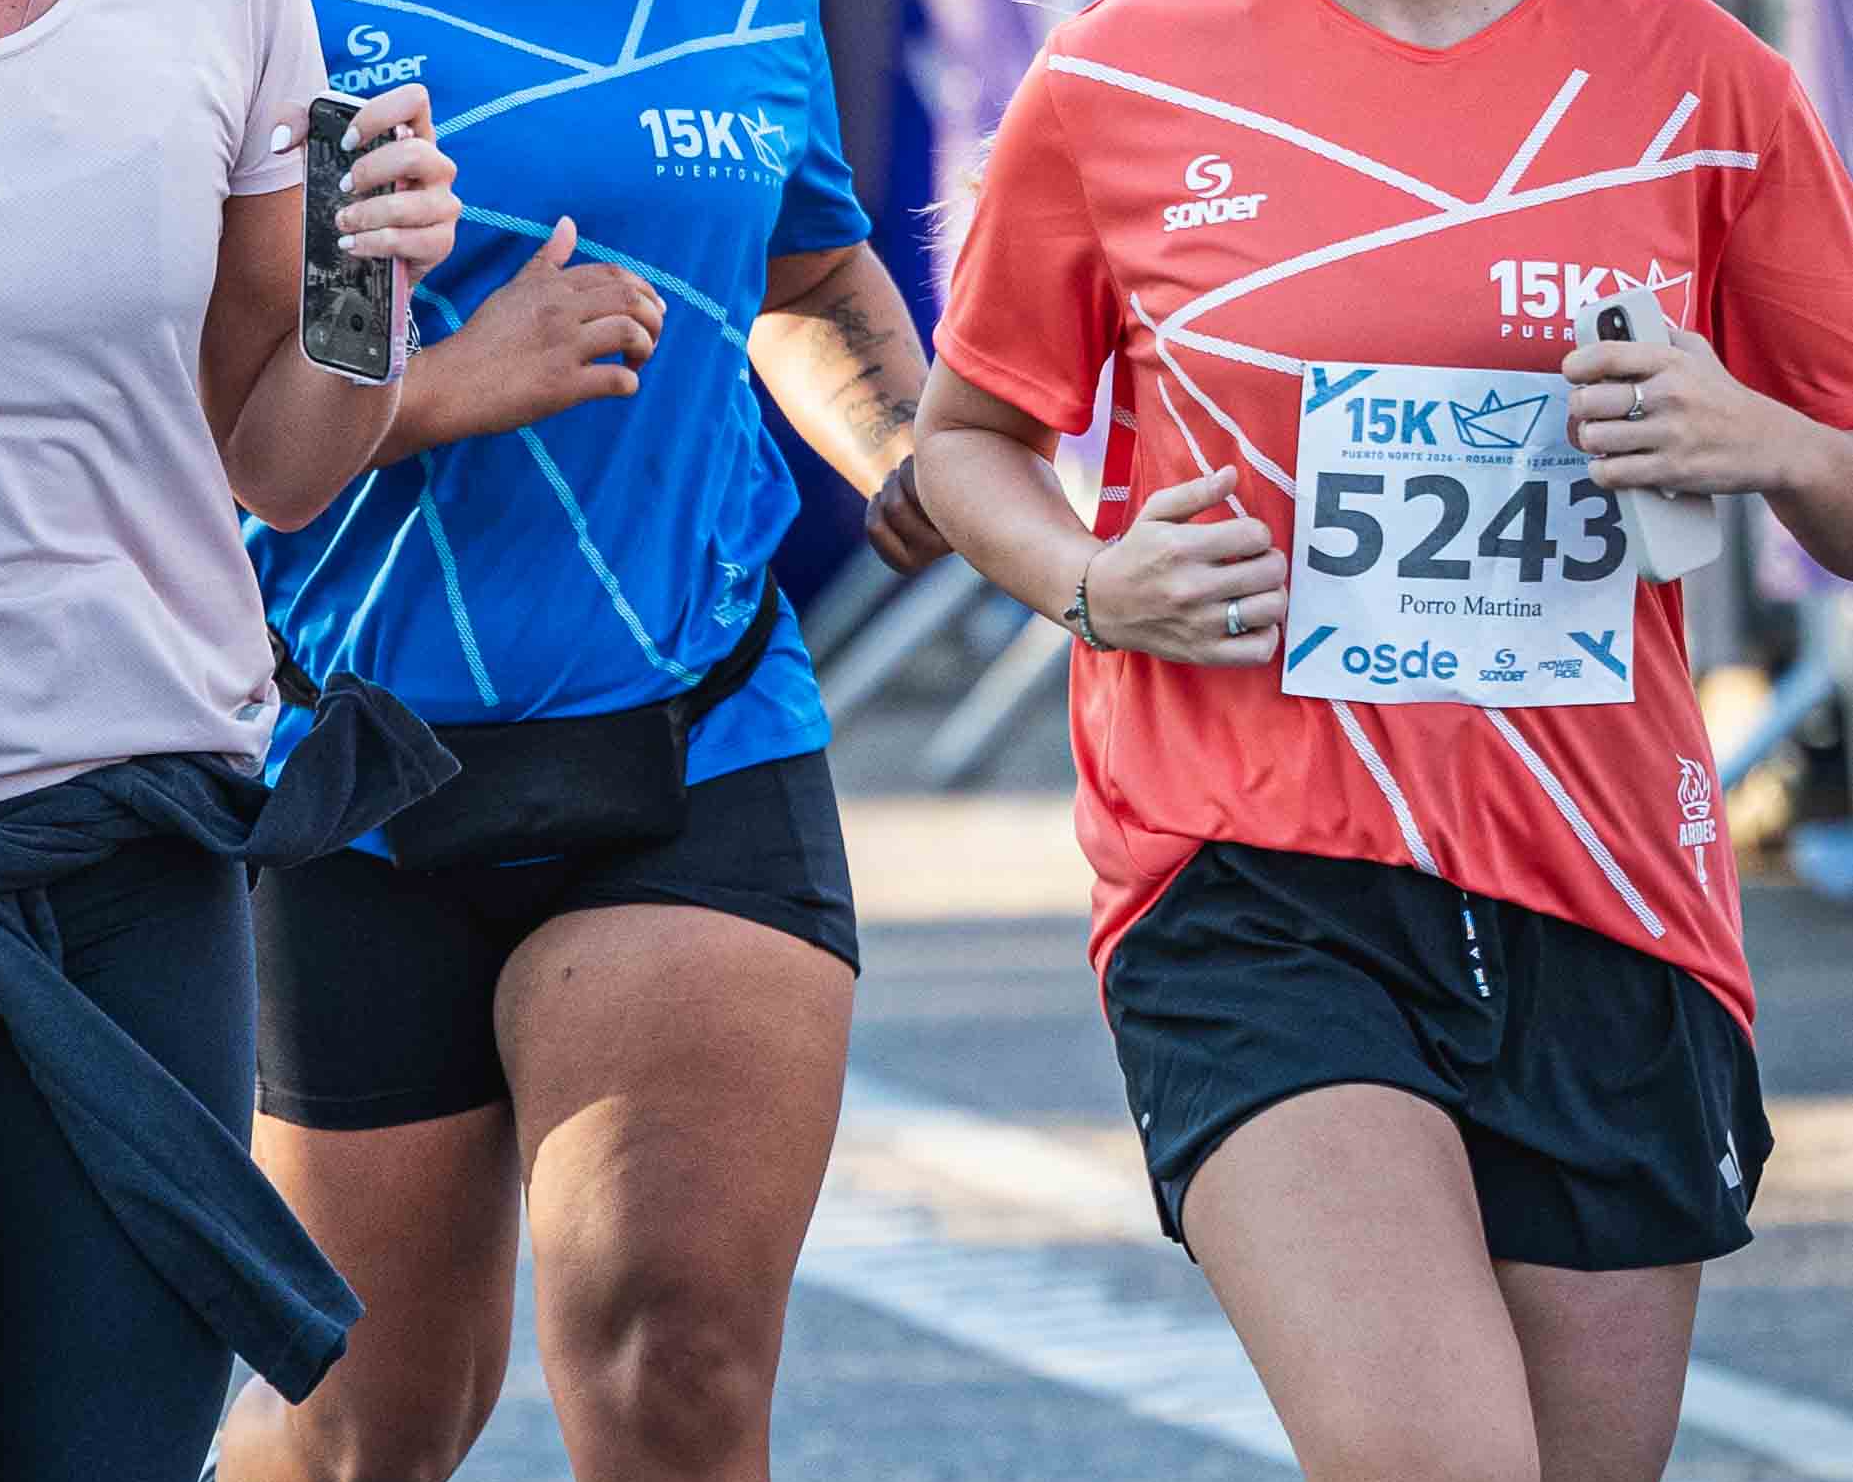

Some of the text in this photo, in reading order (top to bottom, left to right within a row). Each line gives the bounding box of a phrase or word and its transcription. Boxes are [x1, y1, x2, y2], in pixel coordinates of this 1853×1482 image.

[638, 108, 745, 160] 15K
[656, 165, 747, 182] PUERTO
[1489, 259, 1610, 320] 15K
[1500, 323, 1575, 342] PUER
[1345, 397, 1441, 446] 15K
[1341, 449, 1385, 460] PUERTO
[1388, 451, 1423, 461] NORTE
[1465, 454, 1514, 464] ROSARIO
[1306, 471, 1628, 583] 5243
[1399, 593, 1543, 618] Porro Martina
[1341, 639, 1459, 681] osde
[1538, 659, 1582, 671] POWER
